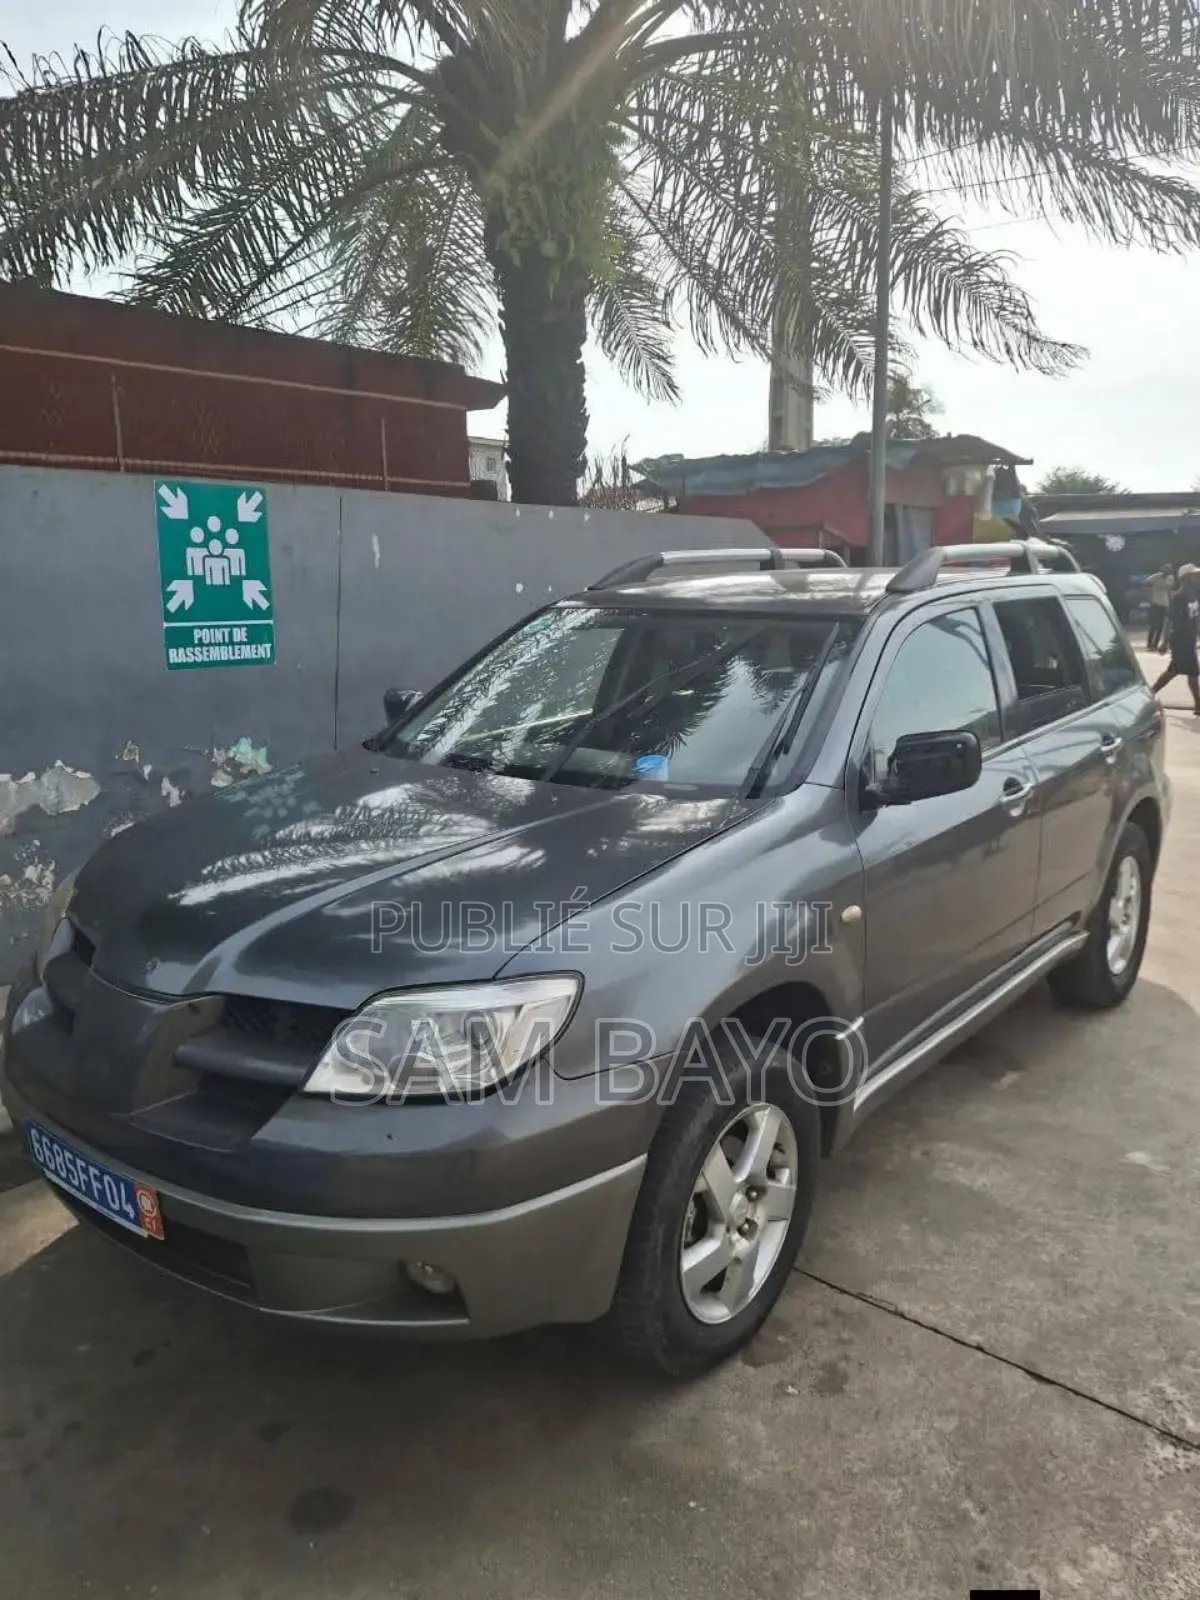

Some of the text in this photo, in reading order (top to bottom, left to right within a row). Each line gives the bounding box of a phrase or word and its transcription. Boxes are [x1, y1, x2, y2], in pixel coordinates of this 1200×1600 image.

[193, 627, 248, 644] POINT DE
[168, 643, 272, 664] RASSEMBLEMENT
[30, 1128, 135, 1219] 6685FF04
